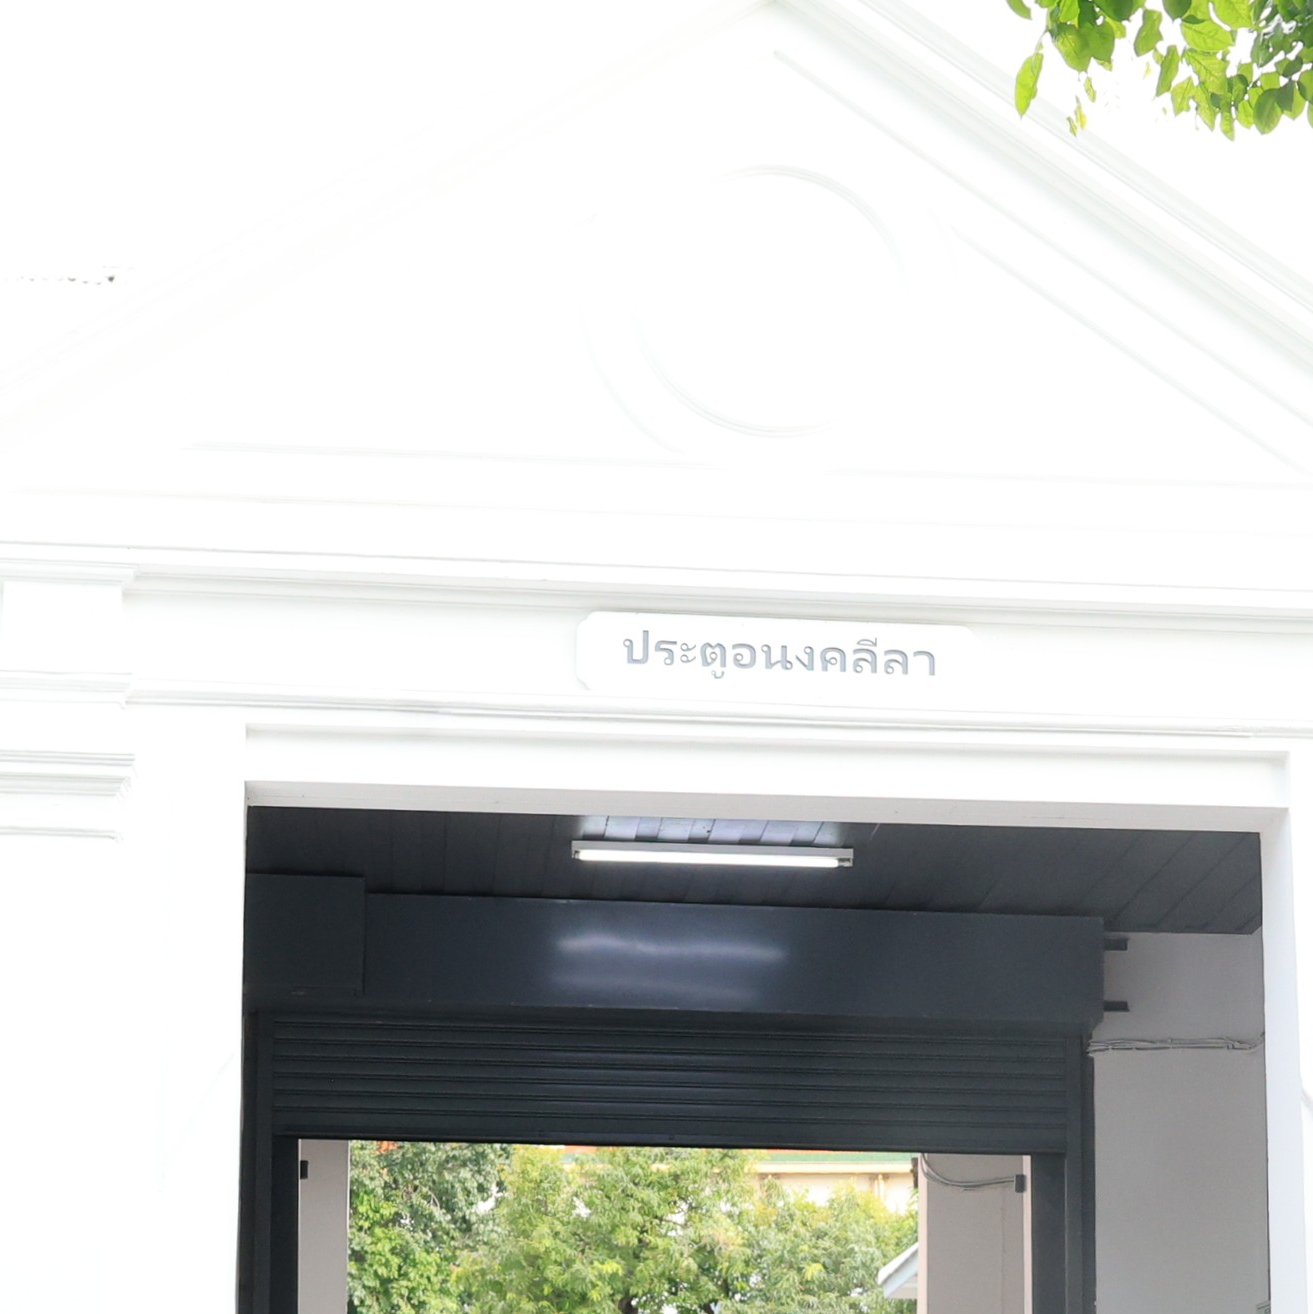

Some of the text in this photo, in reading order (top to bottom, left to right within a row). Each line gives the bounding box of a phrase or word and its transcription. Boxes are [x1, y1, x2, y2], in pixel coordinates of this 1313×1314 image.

[622, 629, 936, 680] ประตูอนงคลีลา
